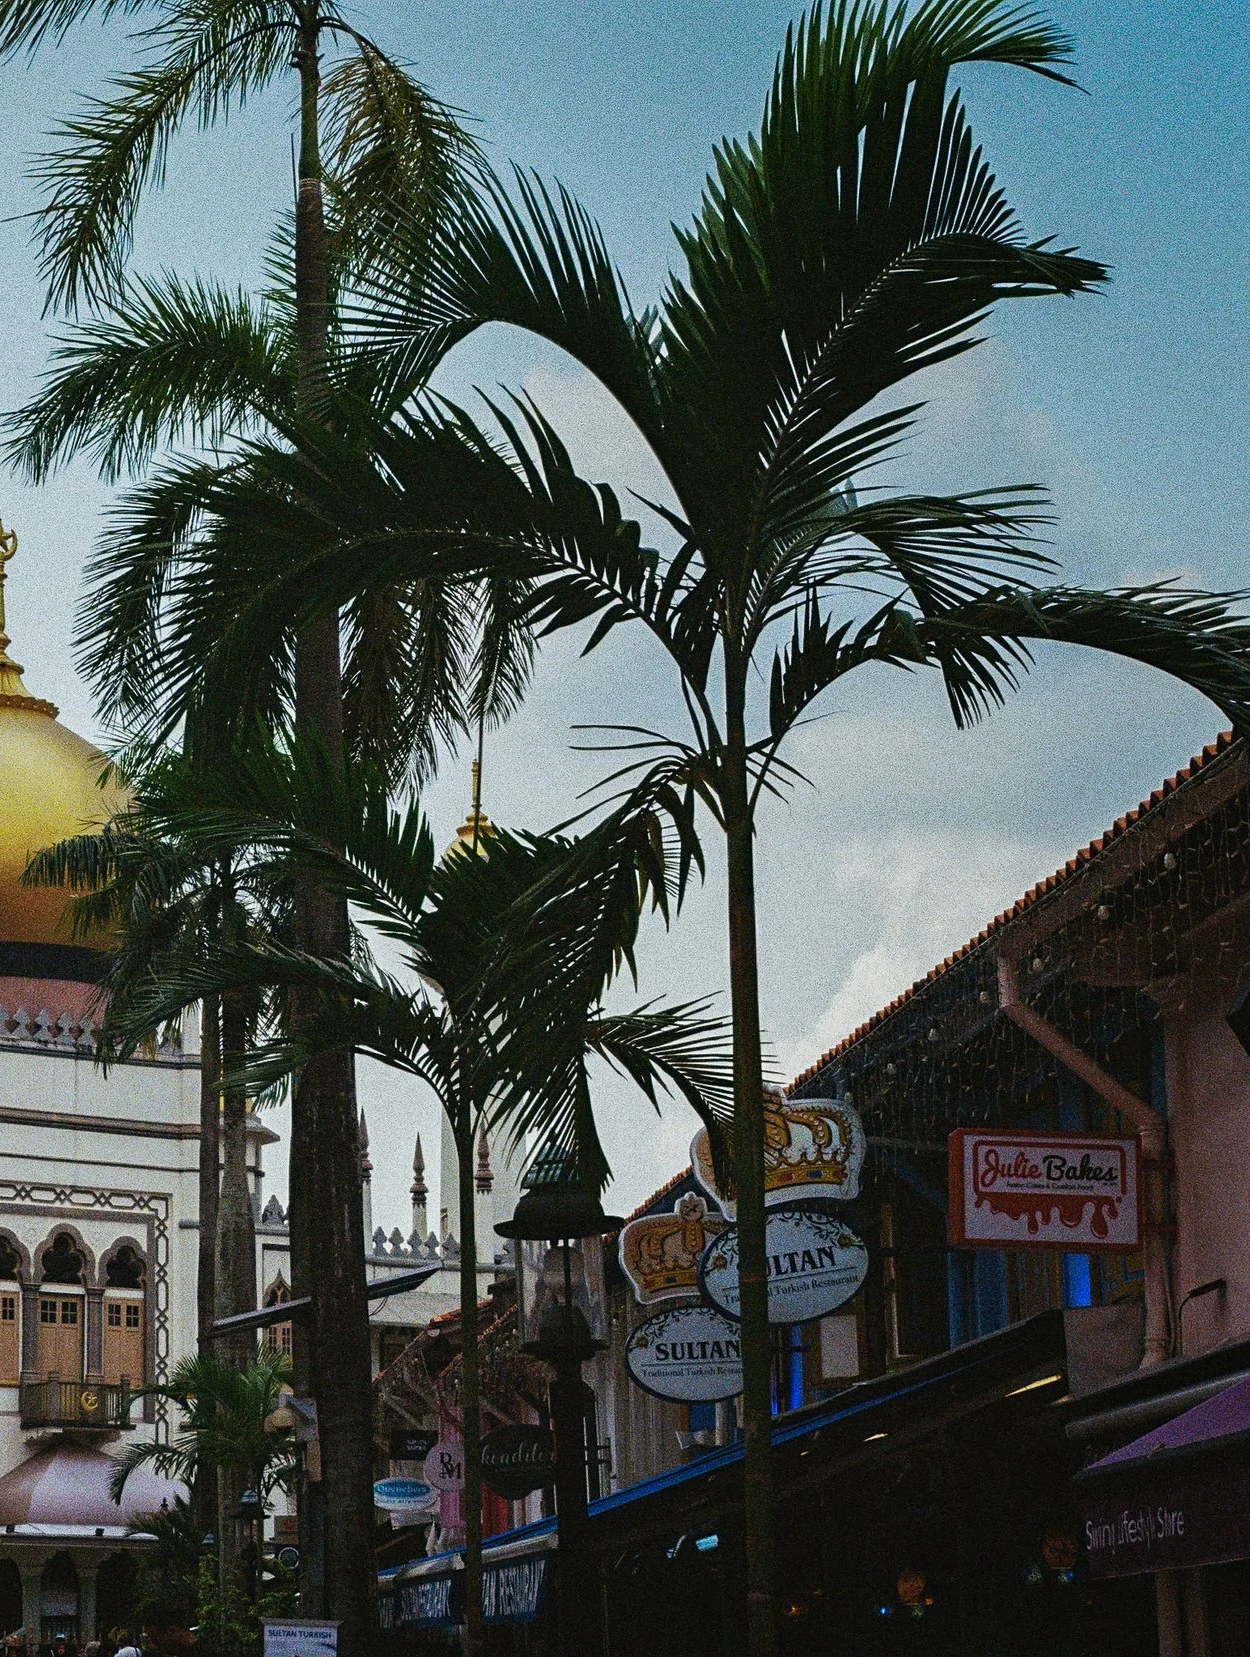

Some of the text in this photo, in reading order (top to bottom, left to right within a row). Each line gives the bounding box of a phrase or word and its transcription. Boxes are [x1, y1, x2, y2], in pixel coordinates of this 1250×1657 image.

[980, 1149, 1119, 1188] Julie Bakes
[774, 1284, 810, 1296] Turkish
[811, 1274, 860, 1290] Restaurant
[655, 1340, 741, 1361] SULTAN
[643, 1367, 684, 1378] Traditional
[686, 1367, 716, 1377] Turkish
[268, 1629, 332, 1639] SULTAN TURKISH
